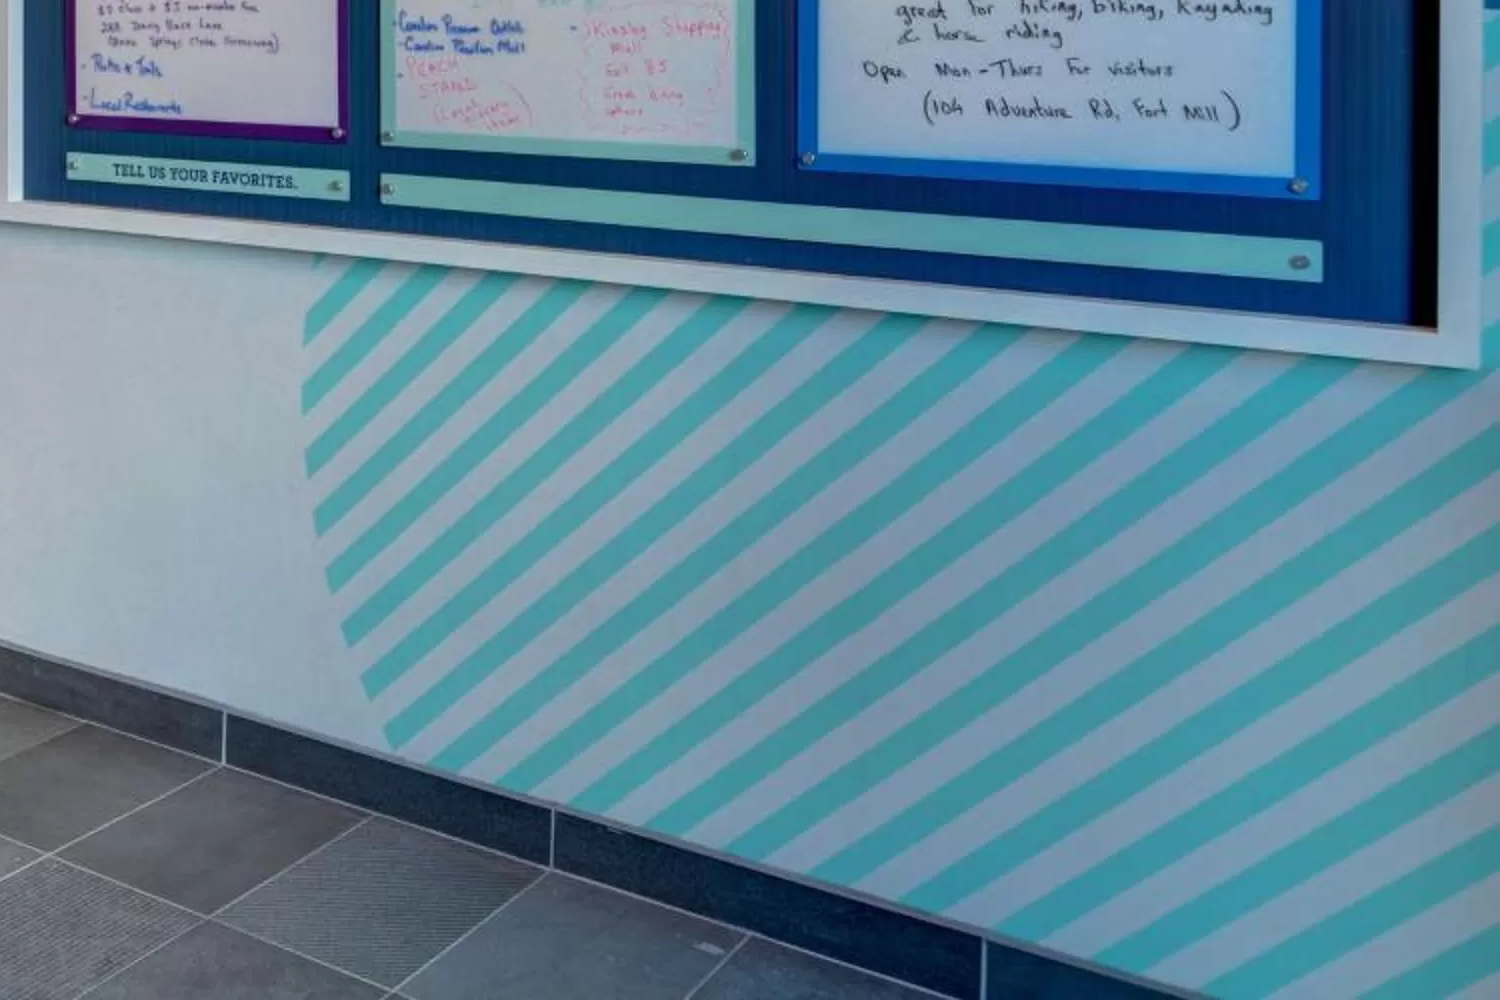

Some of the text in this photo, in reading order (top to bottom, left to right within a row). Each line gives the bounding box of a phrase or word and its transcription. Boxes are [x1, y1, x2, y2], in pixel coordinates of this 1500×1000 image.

[895, 0, 948, 27] great
[1005, 20, 1063, 49] riding
[862, 60, 907, 85] Open
[1107, 58, 1174, 77] visitors
[984, 95, 1073, 119] Adventure
[1133, 97, 1169, 118] Fort
[112, 162, 299, 190] TELL US YOUR FAVORITES.
